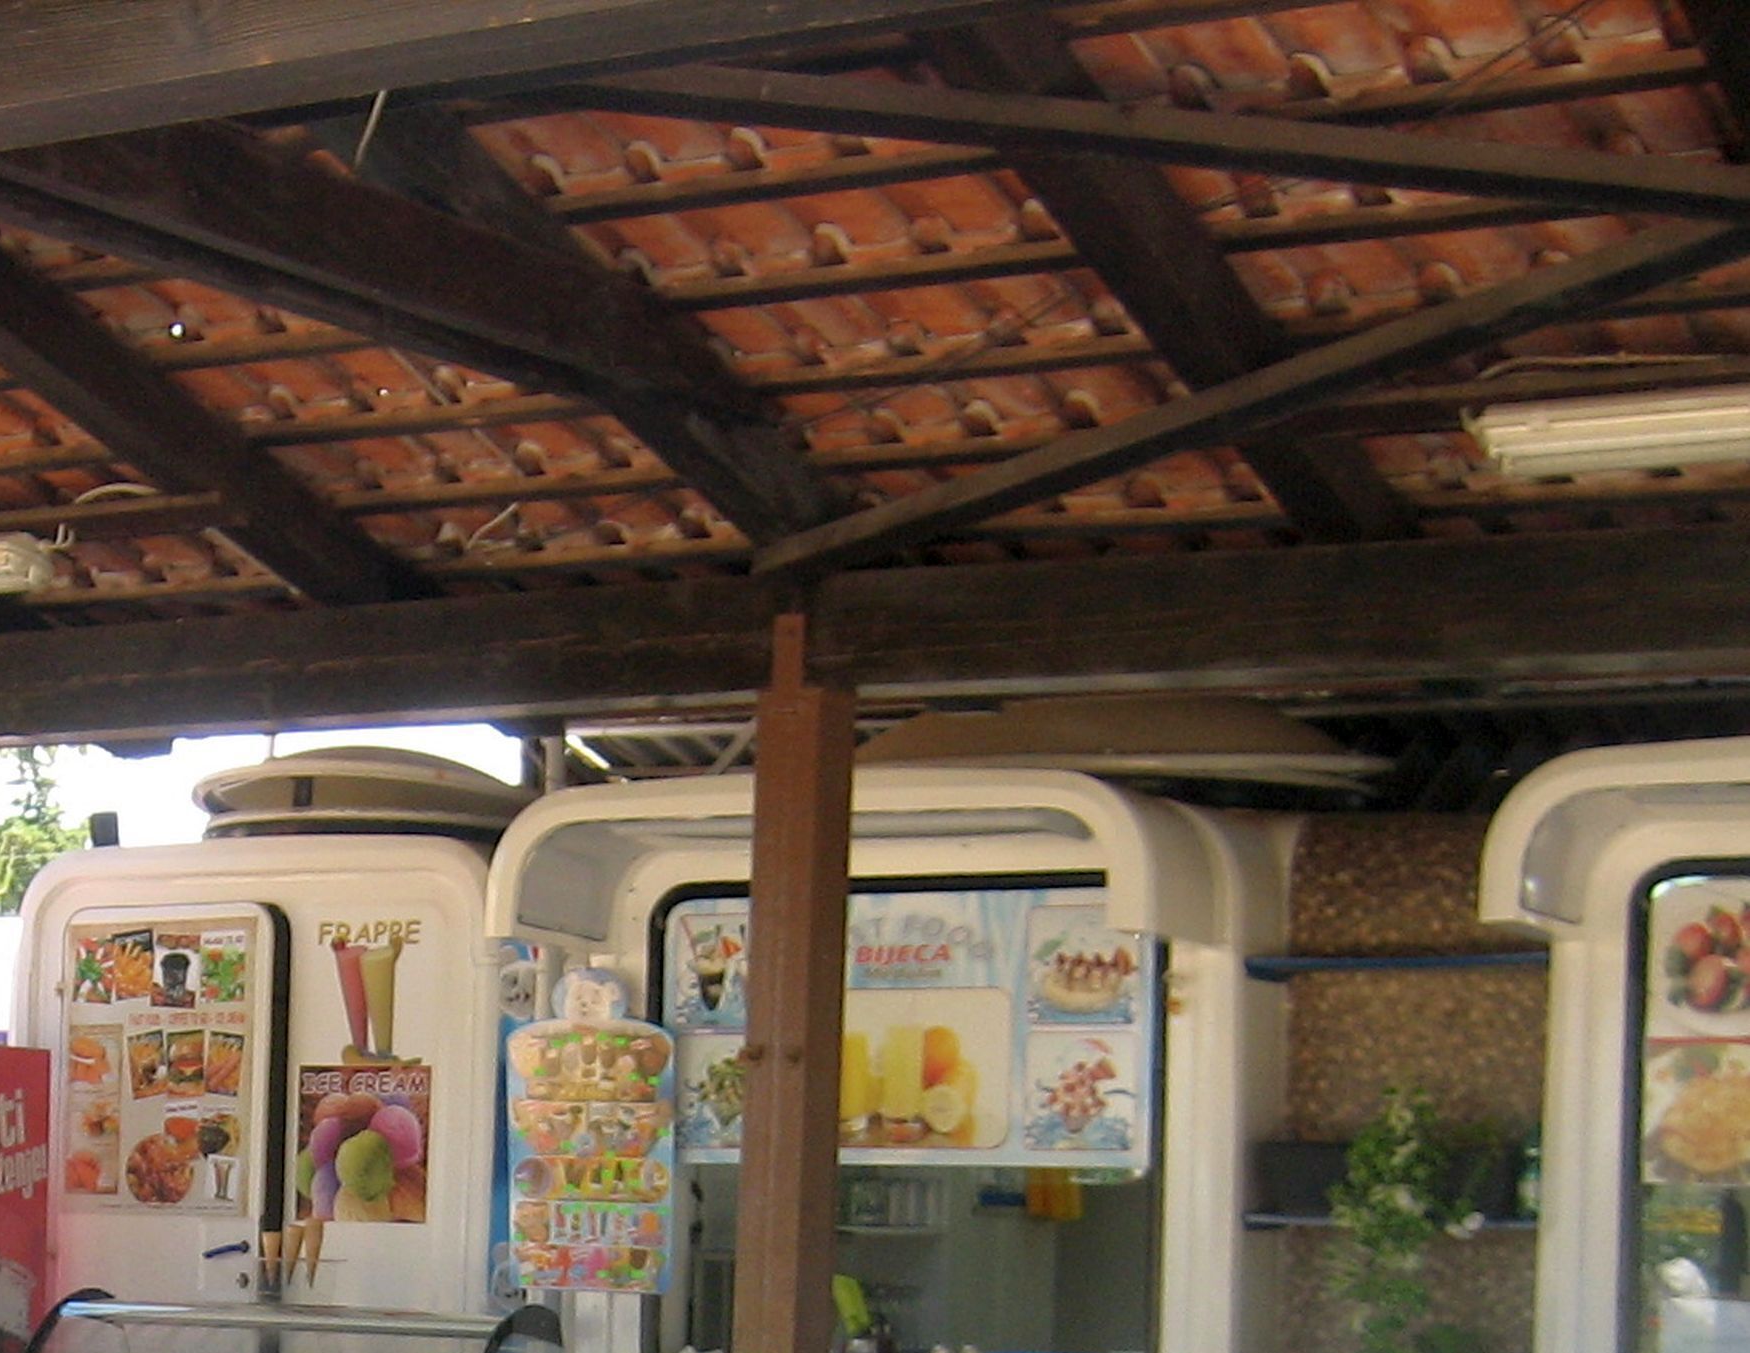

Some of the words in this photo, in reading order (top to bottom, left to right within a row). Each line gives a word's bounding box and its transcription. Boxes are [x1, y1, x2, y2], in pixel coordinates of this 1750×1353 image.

[318, 919, 421, 945] FRAPPE
[856, 943, 953, 966] BIJECA
[301, 1072, 342, 1094] ICE
[350, 1071, 426, 1094] CREAM
